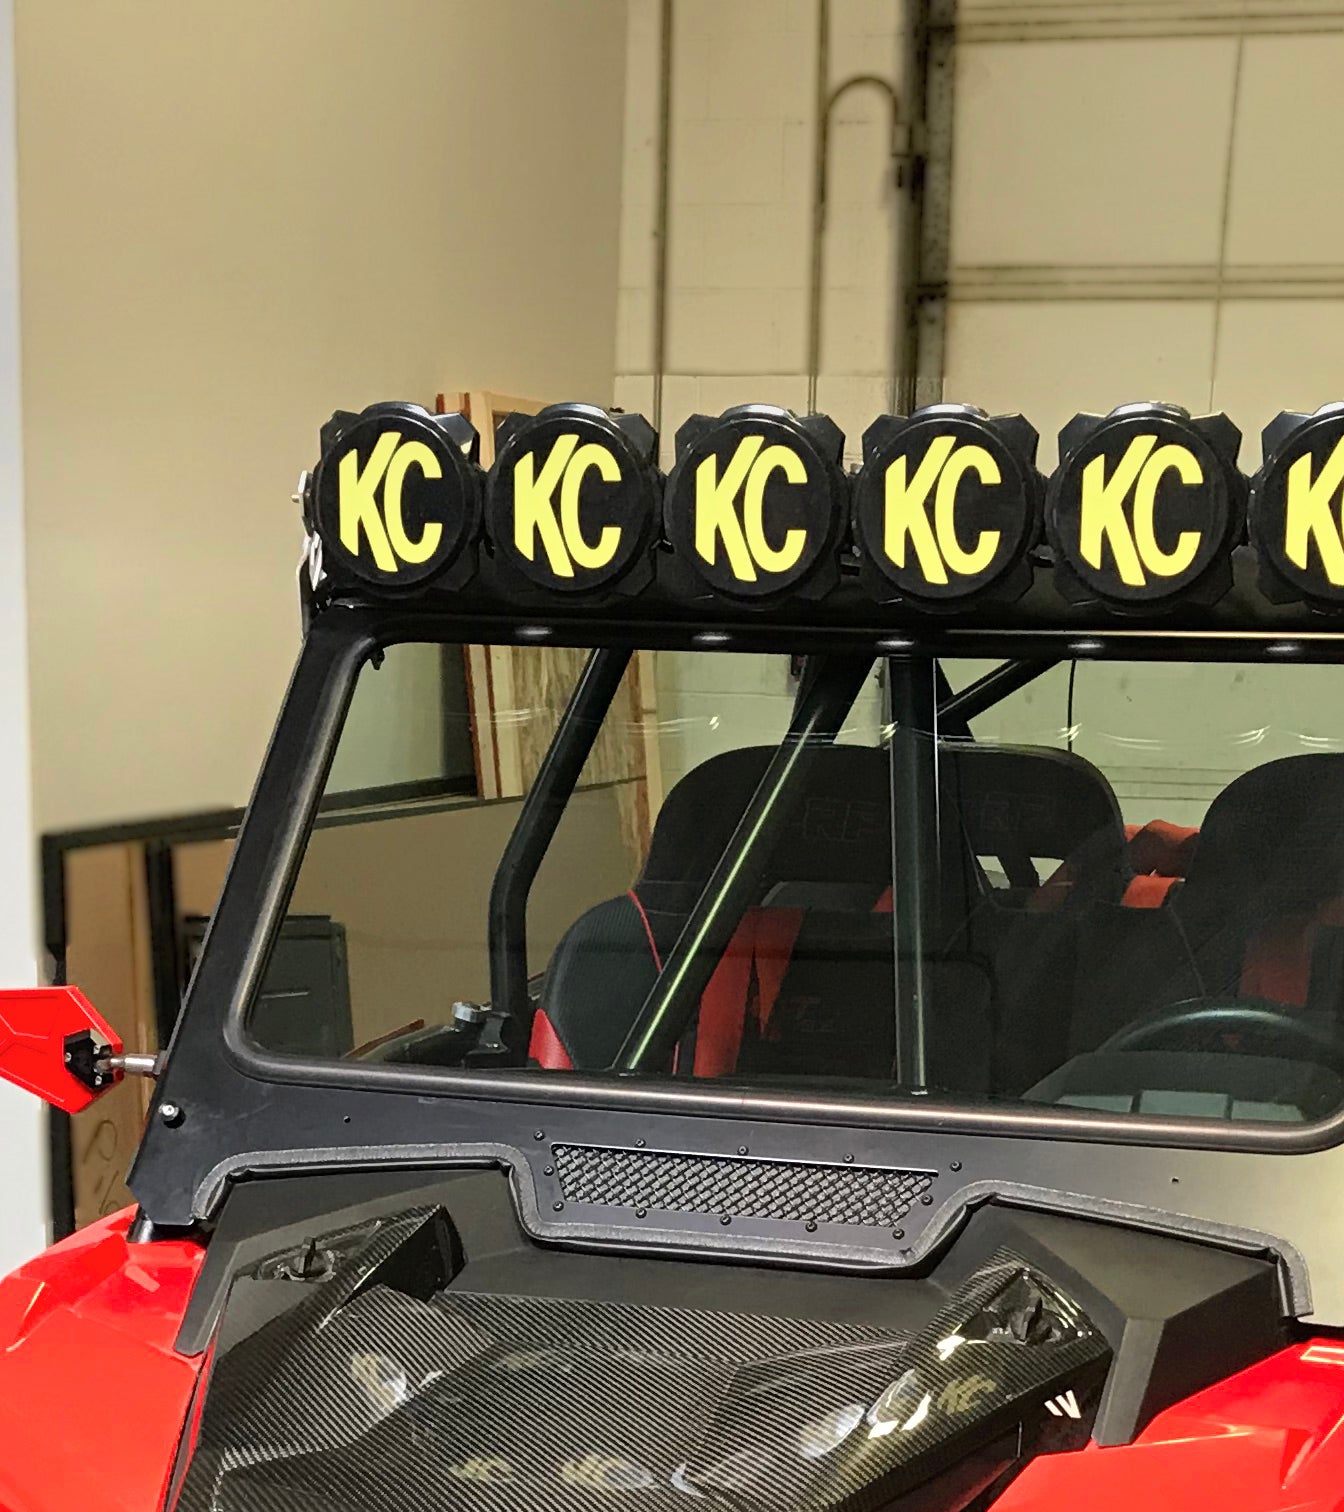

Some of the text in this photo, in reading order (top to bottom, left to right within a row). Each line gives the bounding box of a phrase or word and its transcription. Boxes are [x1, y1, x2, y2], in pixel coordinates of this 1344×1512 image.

[339, 431, 443, 572] KC
[514, 434, 622, 578] KC
[695, 435, 808, 582] KC
[884, 435, 1002, 585] KC
[1080, 434, 1204, 586] KC
